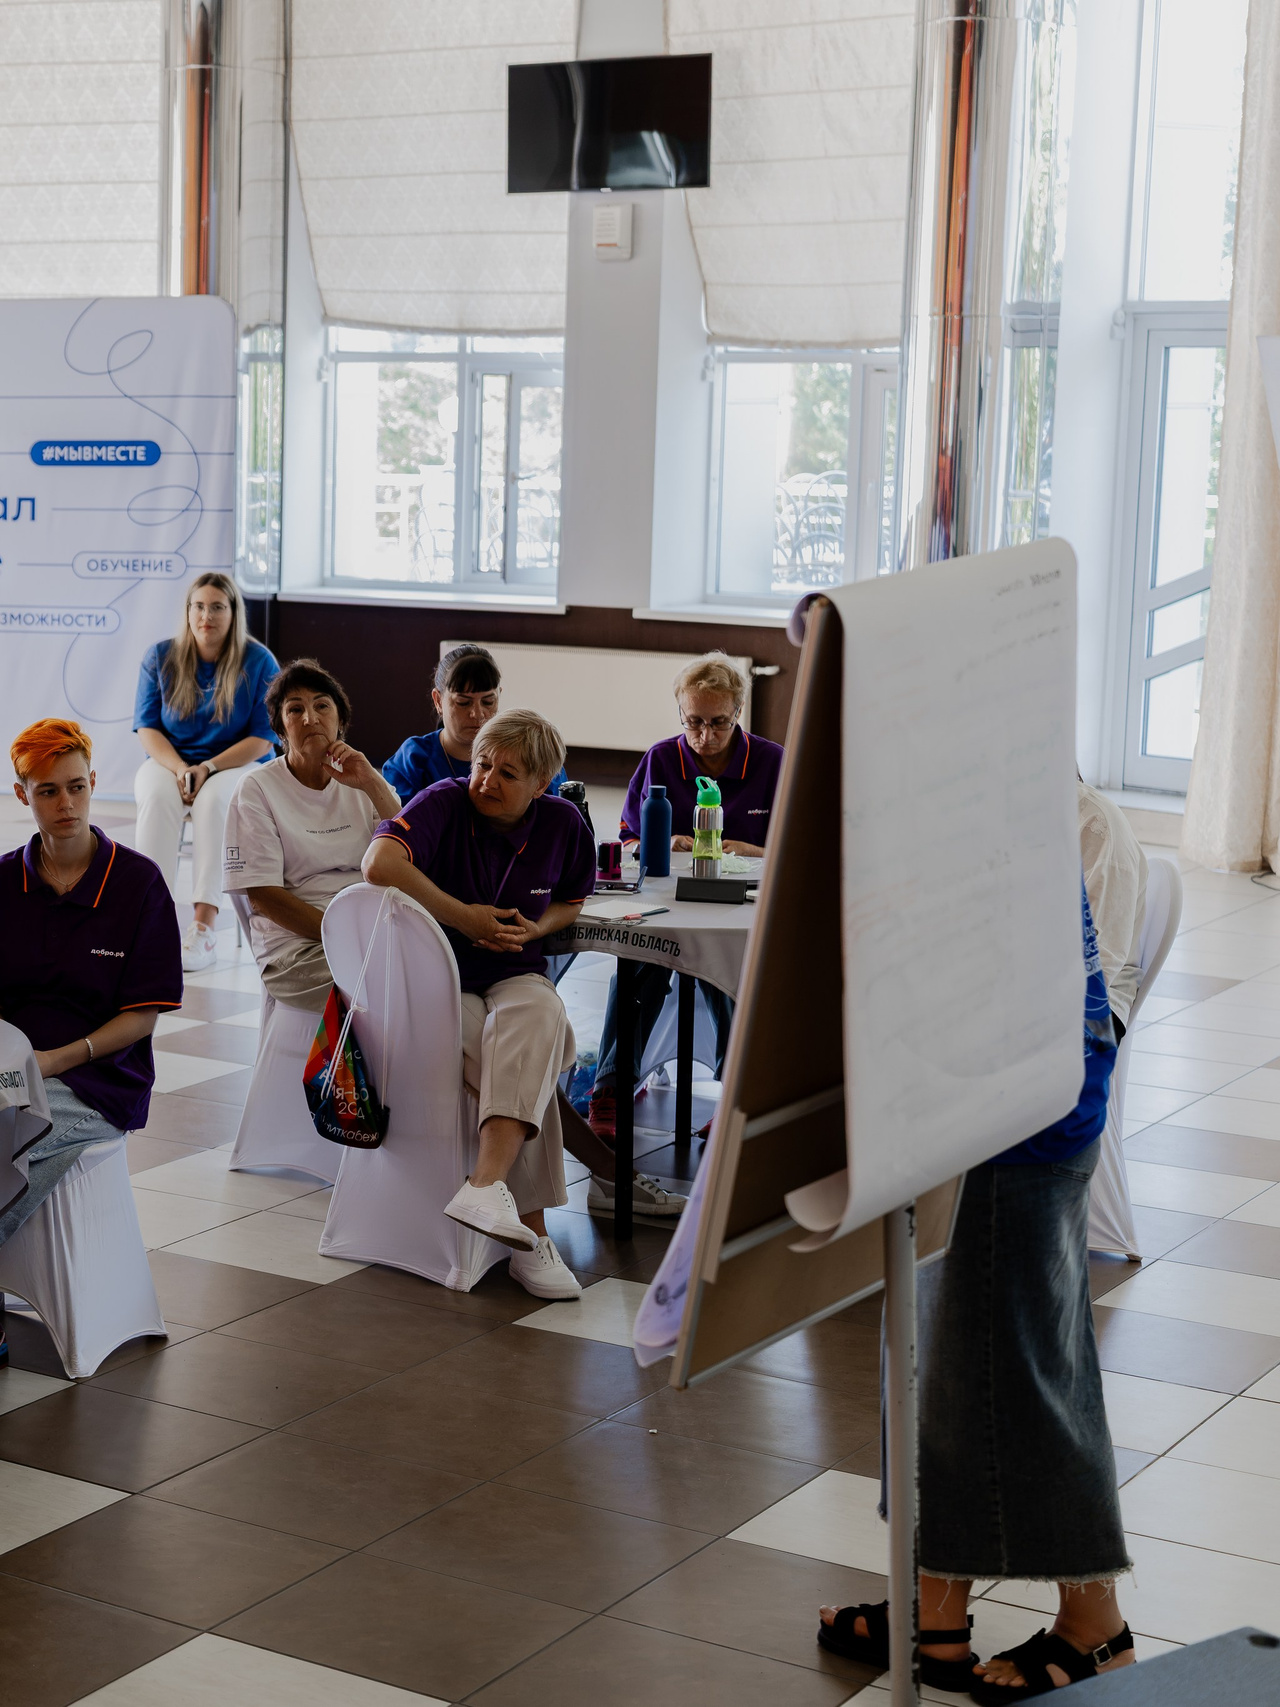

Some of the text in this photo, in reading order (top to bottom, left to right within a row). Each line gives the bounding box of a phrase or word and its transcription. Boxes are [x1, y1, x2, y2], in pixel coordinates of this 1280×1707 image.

[42, 445, 146, 462] #МЫВМЕСТЕ
[86, 558, 173, 573] ОБУЧЕНИЕ
[552, 926, 681, 957] ЧЕЛЯБИНСКАЯ ОБЛАСТЬ
